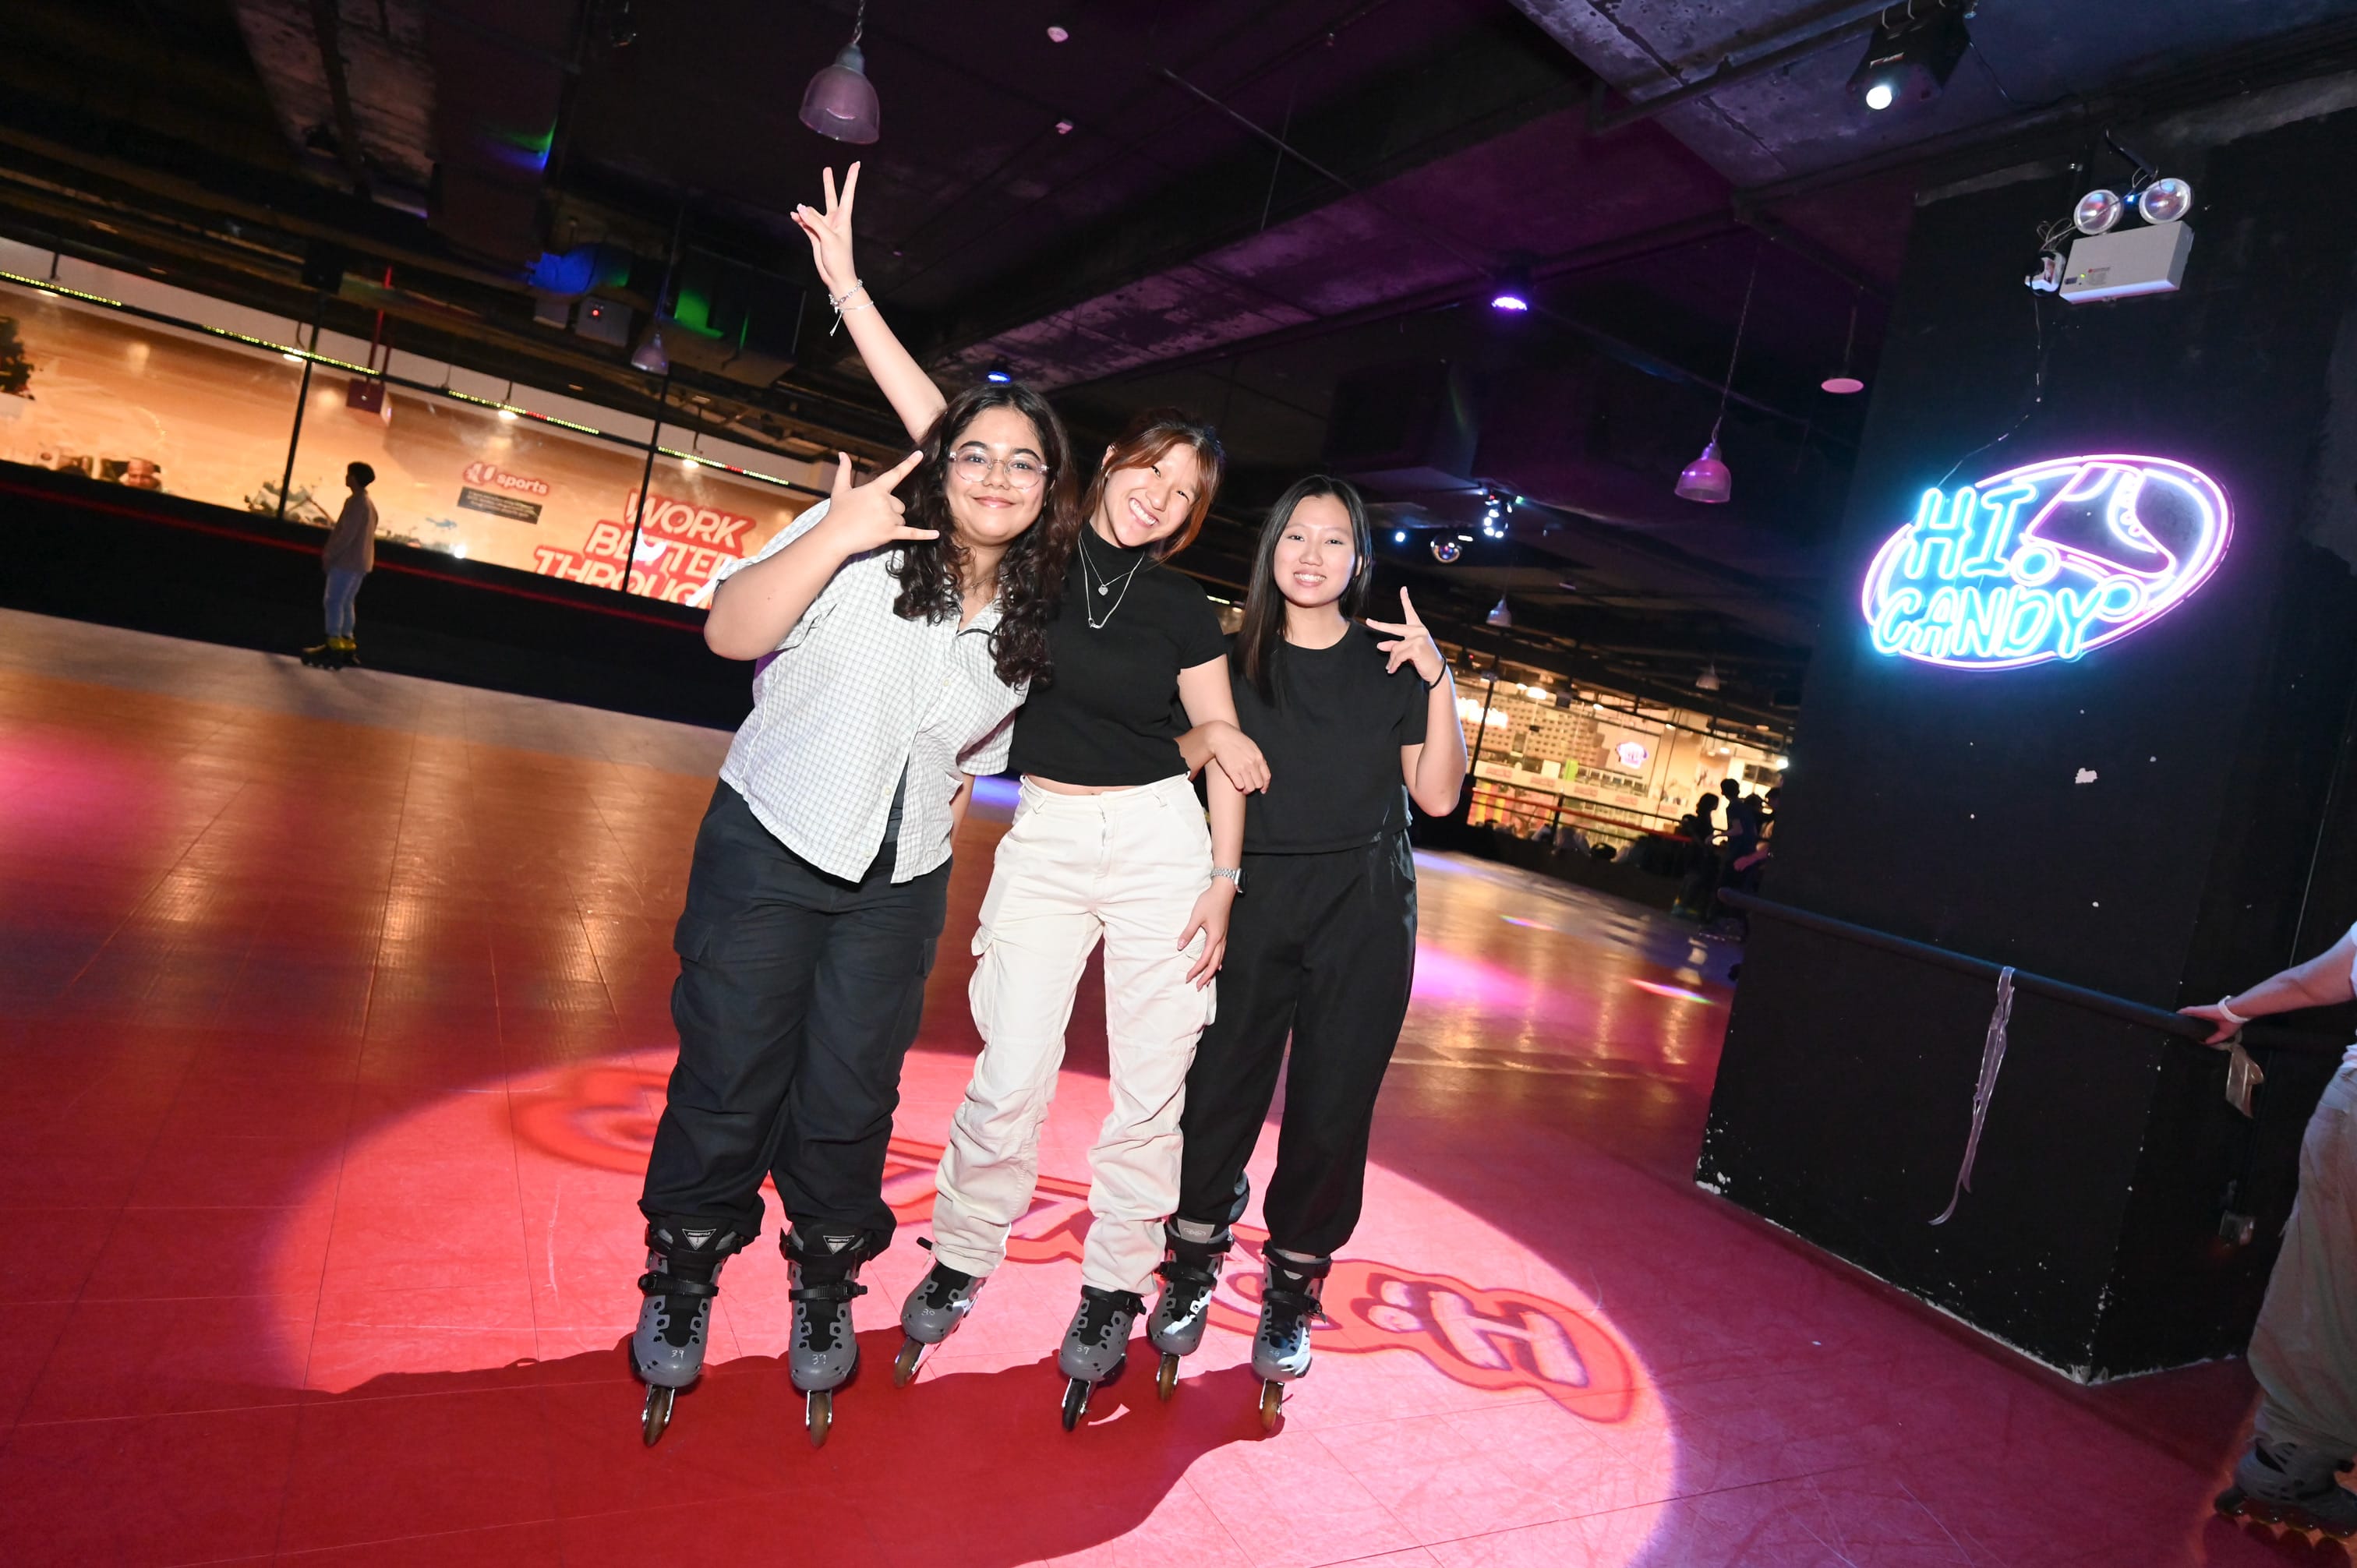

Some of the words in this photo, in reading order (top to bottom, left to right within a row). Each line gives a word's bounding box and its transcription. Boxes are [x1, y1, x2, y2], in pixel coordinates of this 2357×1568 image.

[496, 473, 549, 495] sports
[624, 492, 747, 549] WORK
[1903, 486, 2040, 580] HI
[1872, 584, 2106, 660] CANDY
